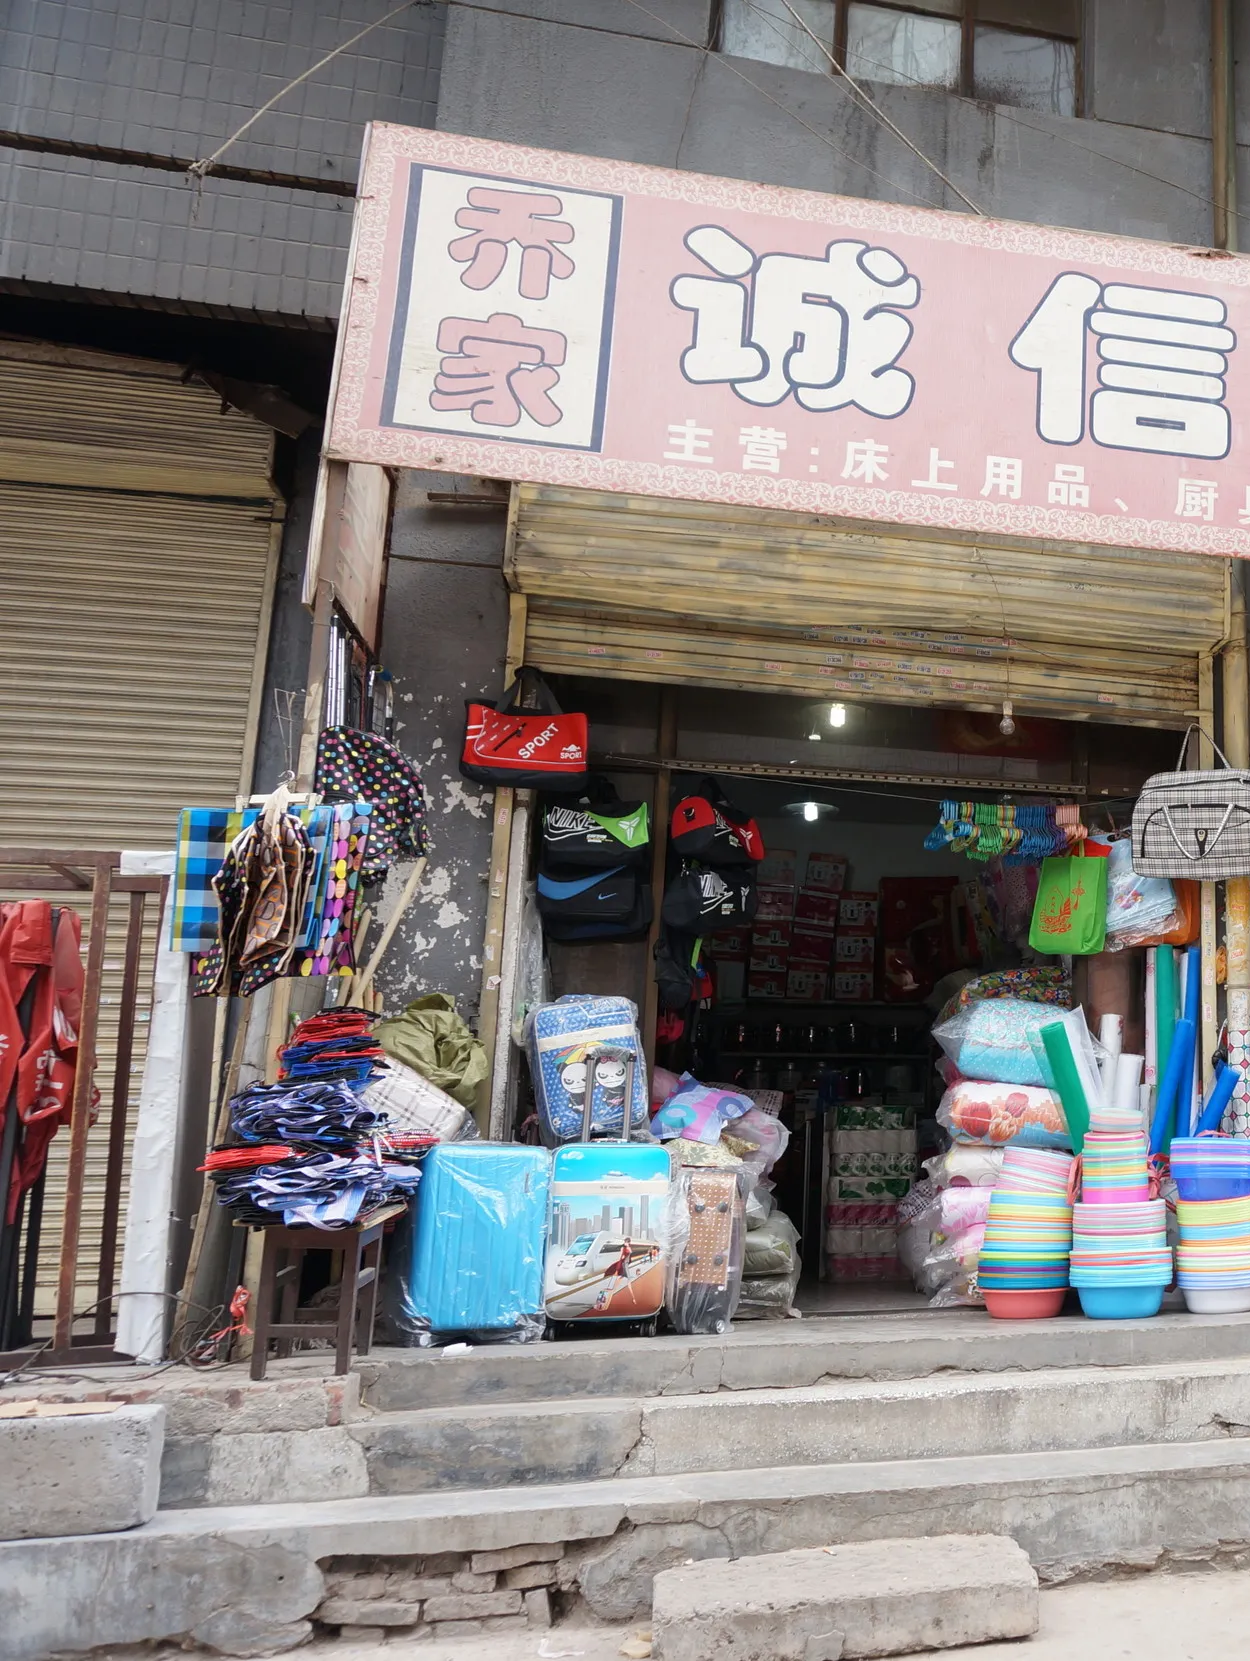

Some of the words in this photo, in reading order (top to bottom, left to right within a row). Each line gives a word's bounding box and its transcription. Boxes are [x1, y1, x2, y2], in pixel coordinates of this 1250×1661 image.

[428, 185, 577, 428] 乔家
[518, 722, 559, 759] SPORT
[560, 751, 582, 760] SPORT
[550, 805, 597, 830] NIKE
